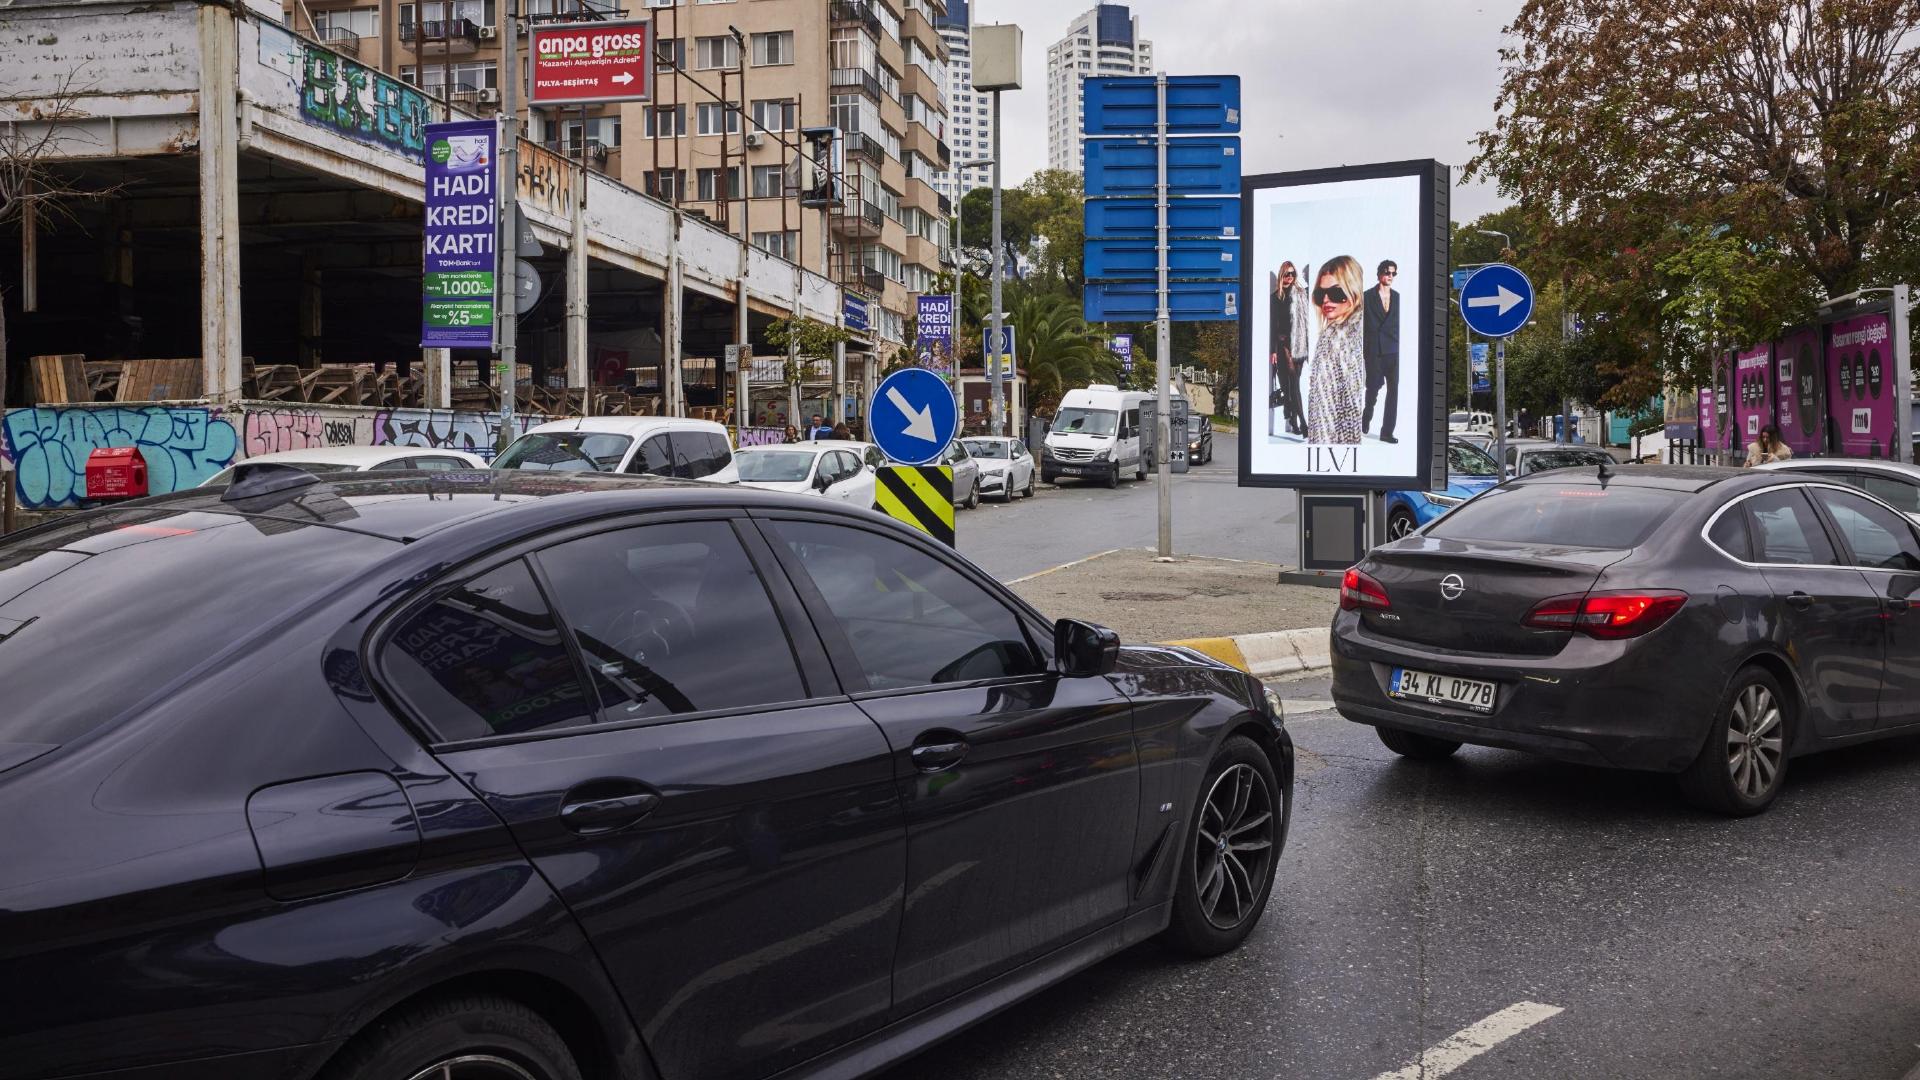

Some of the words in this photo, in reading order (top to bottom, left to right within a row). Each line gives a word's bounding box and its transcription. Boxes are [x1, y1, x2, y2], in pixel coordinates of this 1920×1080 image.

[539, 36, 587, 57] anpa
[592, 33, 641, 57] gross
[537, 78, 598, 87] FULYA-BEŞİKTAŞ
[433, 168, 490, 196] HADİ
[426, 198, 494, 227] KREDİ
[426, 233, 493, 255] KARTI
[441, 281, 480, 295] 1.000
[921, 300, 949, 312] HADİ
[448, 310, 469, 325] %5
[918, 312, 951, 323] KREDİ
[918, 325, 951, 335] KARTI
[1307, 447, 1357, 472] ILVI
[1379, 613, 1400, 621] ASTRA
[1401, 671, 1419, 693] 34
[1426, 675, 1444, 698] KL
[1450, 680, 1493, 705] 0778
